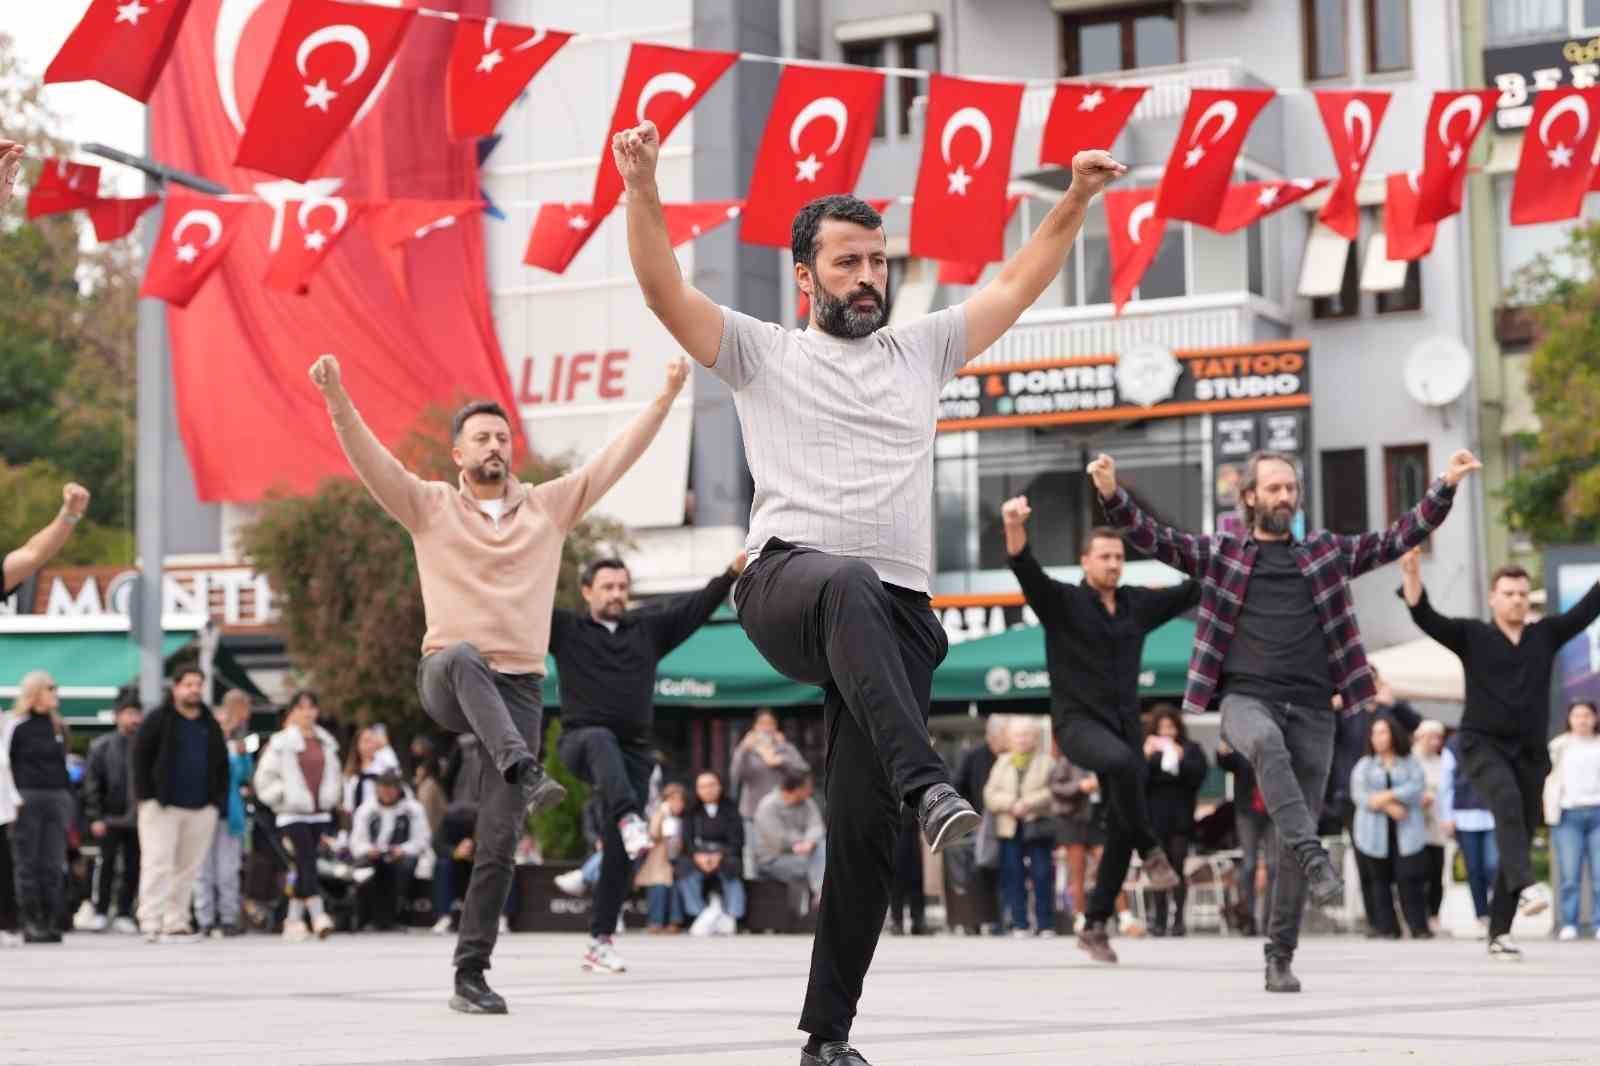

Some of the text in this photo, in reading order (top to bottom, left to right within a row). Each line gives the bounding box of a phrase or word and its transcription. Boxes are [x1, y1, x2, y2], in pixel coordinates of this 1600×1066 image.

[520, 350, 631, 405] LIFE
[1008, 365, 1116, 397] PORTRE
[1190, 353, 1303, 379] TATTOO
[1195, 373, 1300, 401] STUDIO
